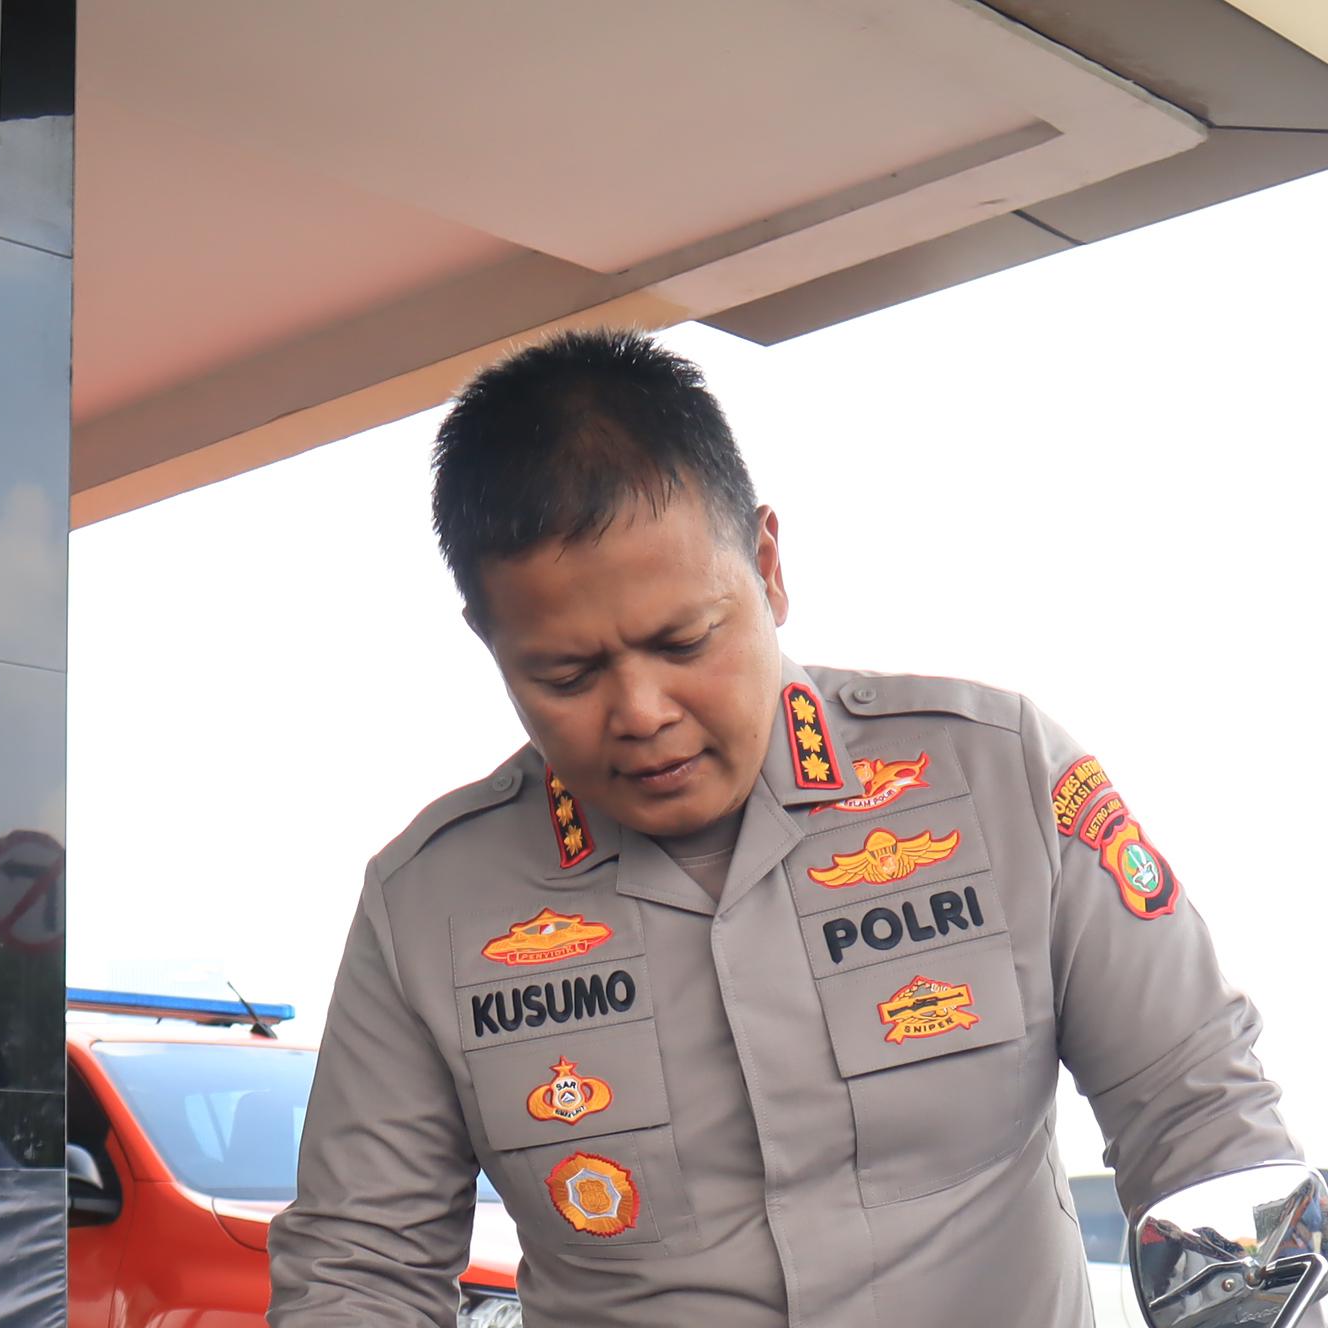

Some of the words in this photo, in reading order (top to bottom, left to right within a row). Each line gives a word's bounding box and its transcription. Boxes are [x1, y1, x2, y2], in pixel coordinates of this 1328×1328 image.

[822, 886, 985, 965] POLRI
[472, 970, 636, 1037] KUSUMO
[904, 1016, 954, 1033] SNIPER
[556, 1081, 576, 1090] SAR
